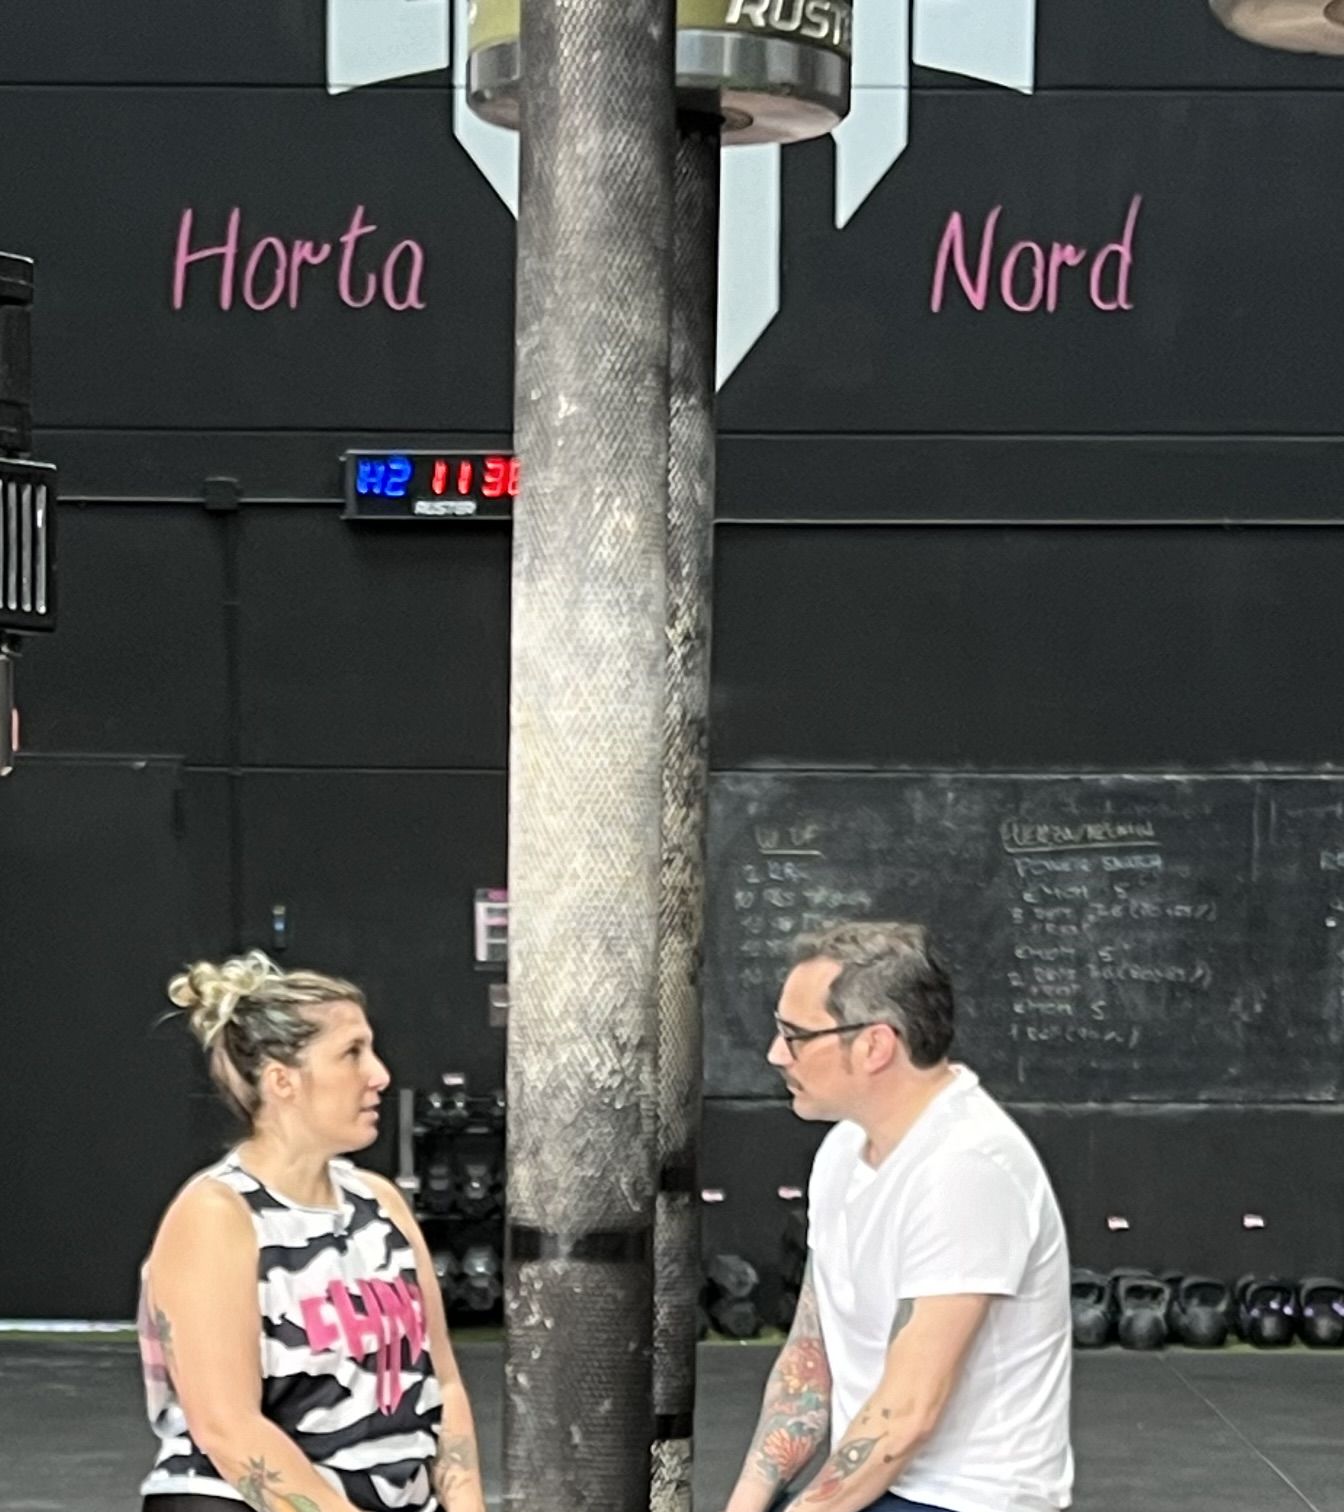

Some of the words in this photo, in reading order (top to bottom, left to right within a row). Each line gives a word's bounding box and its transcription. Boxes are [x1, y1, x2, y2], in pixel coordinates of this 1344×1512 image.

[725, 0, 851, 46] RUST
[172, 204, 428, 312] Horta
[931, 193, 1143, 313] Nord
